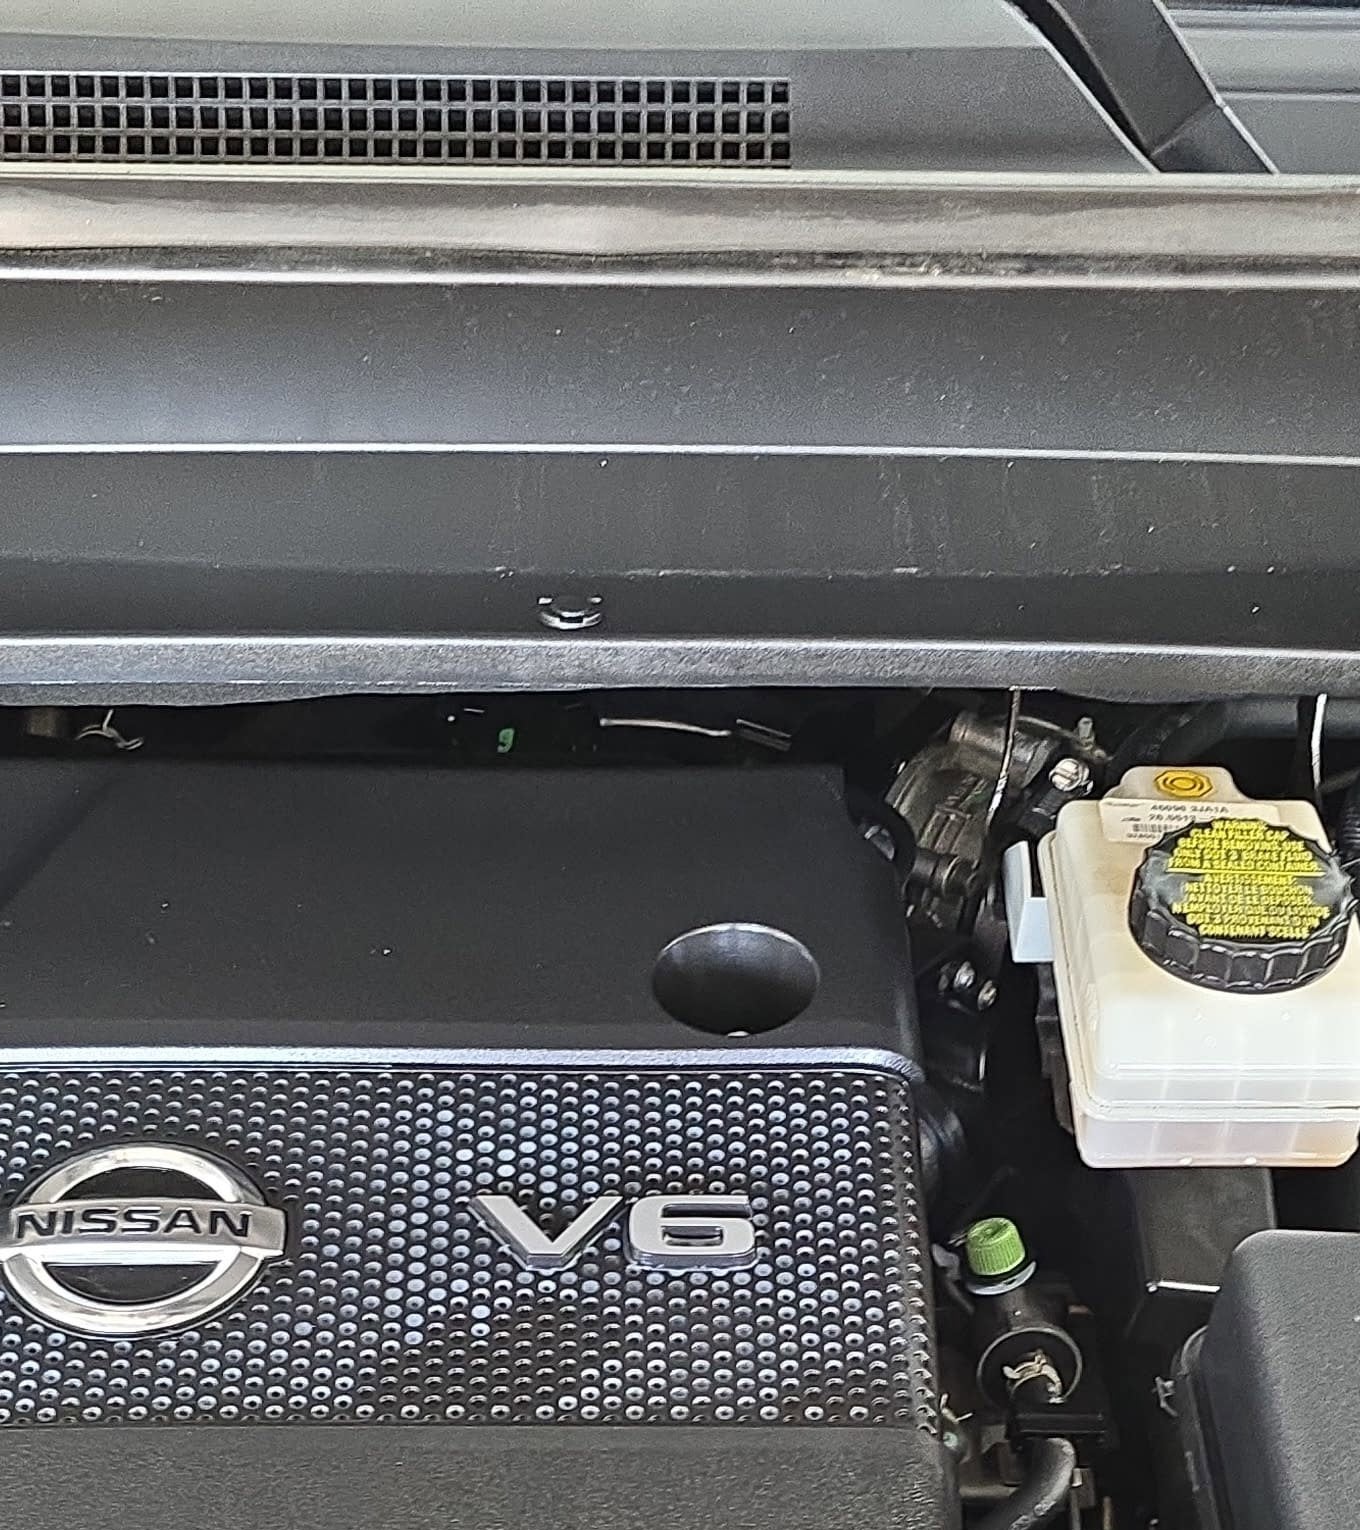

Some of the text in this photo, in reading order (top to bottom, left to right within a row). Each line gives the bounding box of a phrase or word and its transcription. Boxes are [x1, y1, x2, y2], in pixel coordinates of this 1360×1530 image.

[1189, 828, 1291, 841] CLEAN FILLER CAP
[1177, 837, 1221, 849] BEFORE
[1281, 840, 1306, 851] USE
[1173, 847, 1313, 862] ONLY DOT 3 BRAKE FLUID
[1168, 857, 1201, 869] FROM
[1202, 859, 1212, 870] A
[1212, 860, 1255, 871] SEALED
[16, 1207, 251, 1239] NISSAN
[468, 1194, 758, 1270] V6
